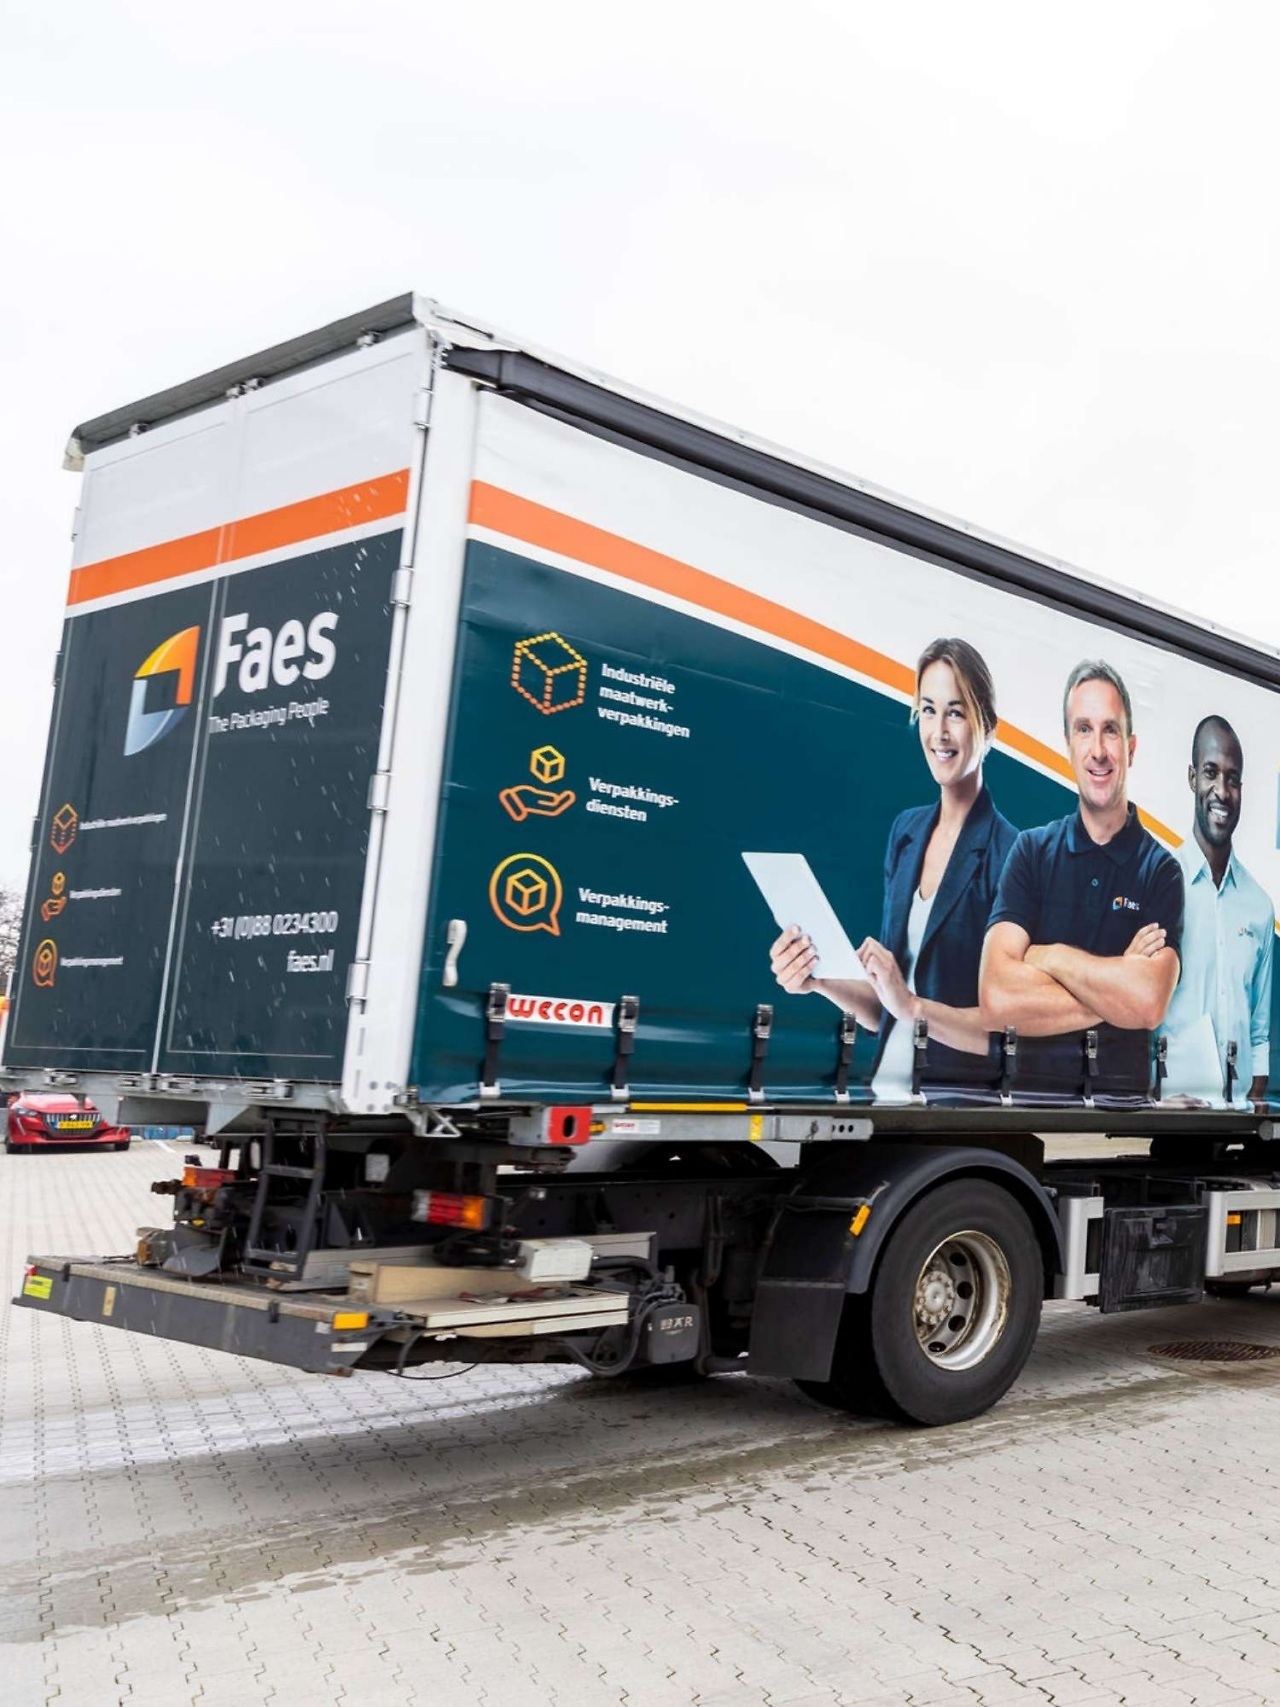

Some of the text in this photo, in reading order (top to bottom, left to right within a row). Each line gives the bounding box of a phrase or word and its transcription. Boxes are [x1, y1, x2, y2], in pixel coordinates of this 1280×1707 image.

[213, 611, 340, 698] Faes
[601, 663, 676, 694] Industriële
[599, 686, 674, 713] maatwerk-
[208, 697, 330, 734] The Packaging People
[597, 706, 690, 738] verpakkingen
[588, 776, 679, 808] Verpakkings-
[585, 798, 648, 822] diensten
[578, 887, 670, 915] Verpakkings-
[210, 916, 235, 938] +31
[272, 910, 339, 936] 0234300
[575, 911, 669, 934] management
[286, 948, 335, 972] faes.nl
